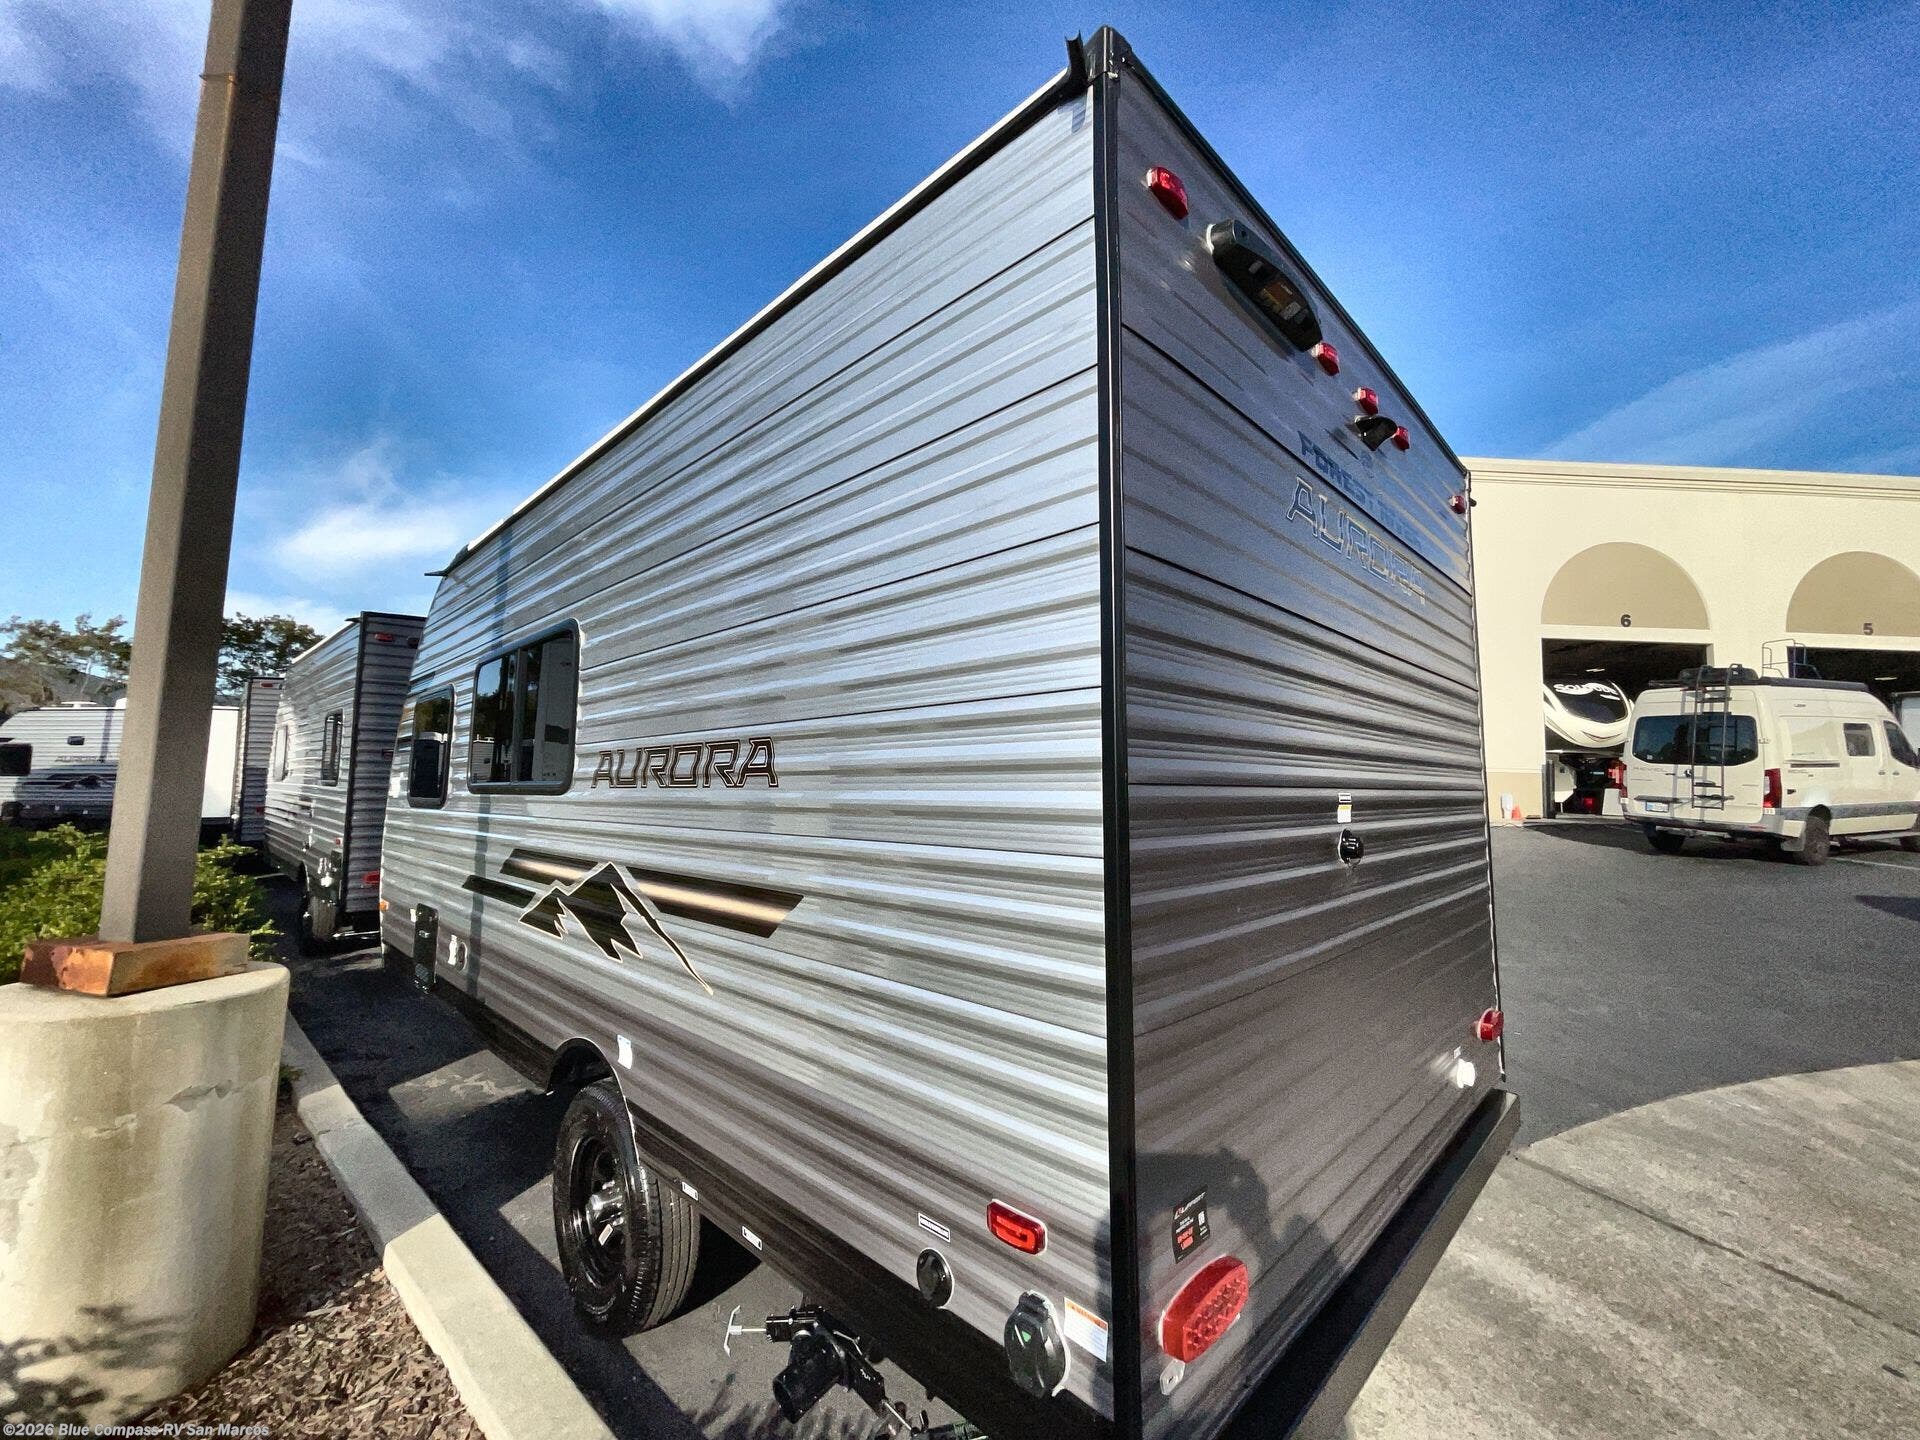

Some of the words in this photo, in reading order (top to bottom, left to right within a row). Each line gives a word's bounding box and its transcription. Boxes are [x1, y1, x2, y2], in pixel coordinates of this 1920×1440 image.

[1620, 613, 1632, 628] 6
[1863, 622, 1874, 636] 5
[591, 736, 779, 789] AURORA
